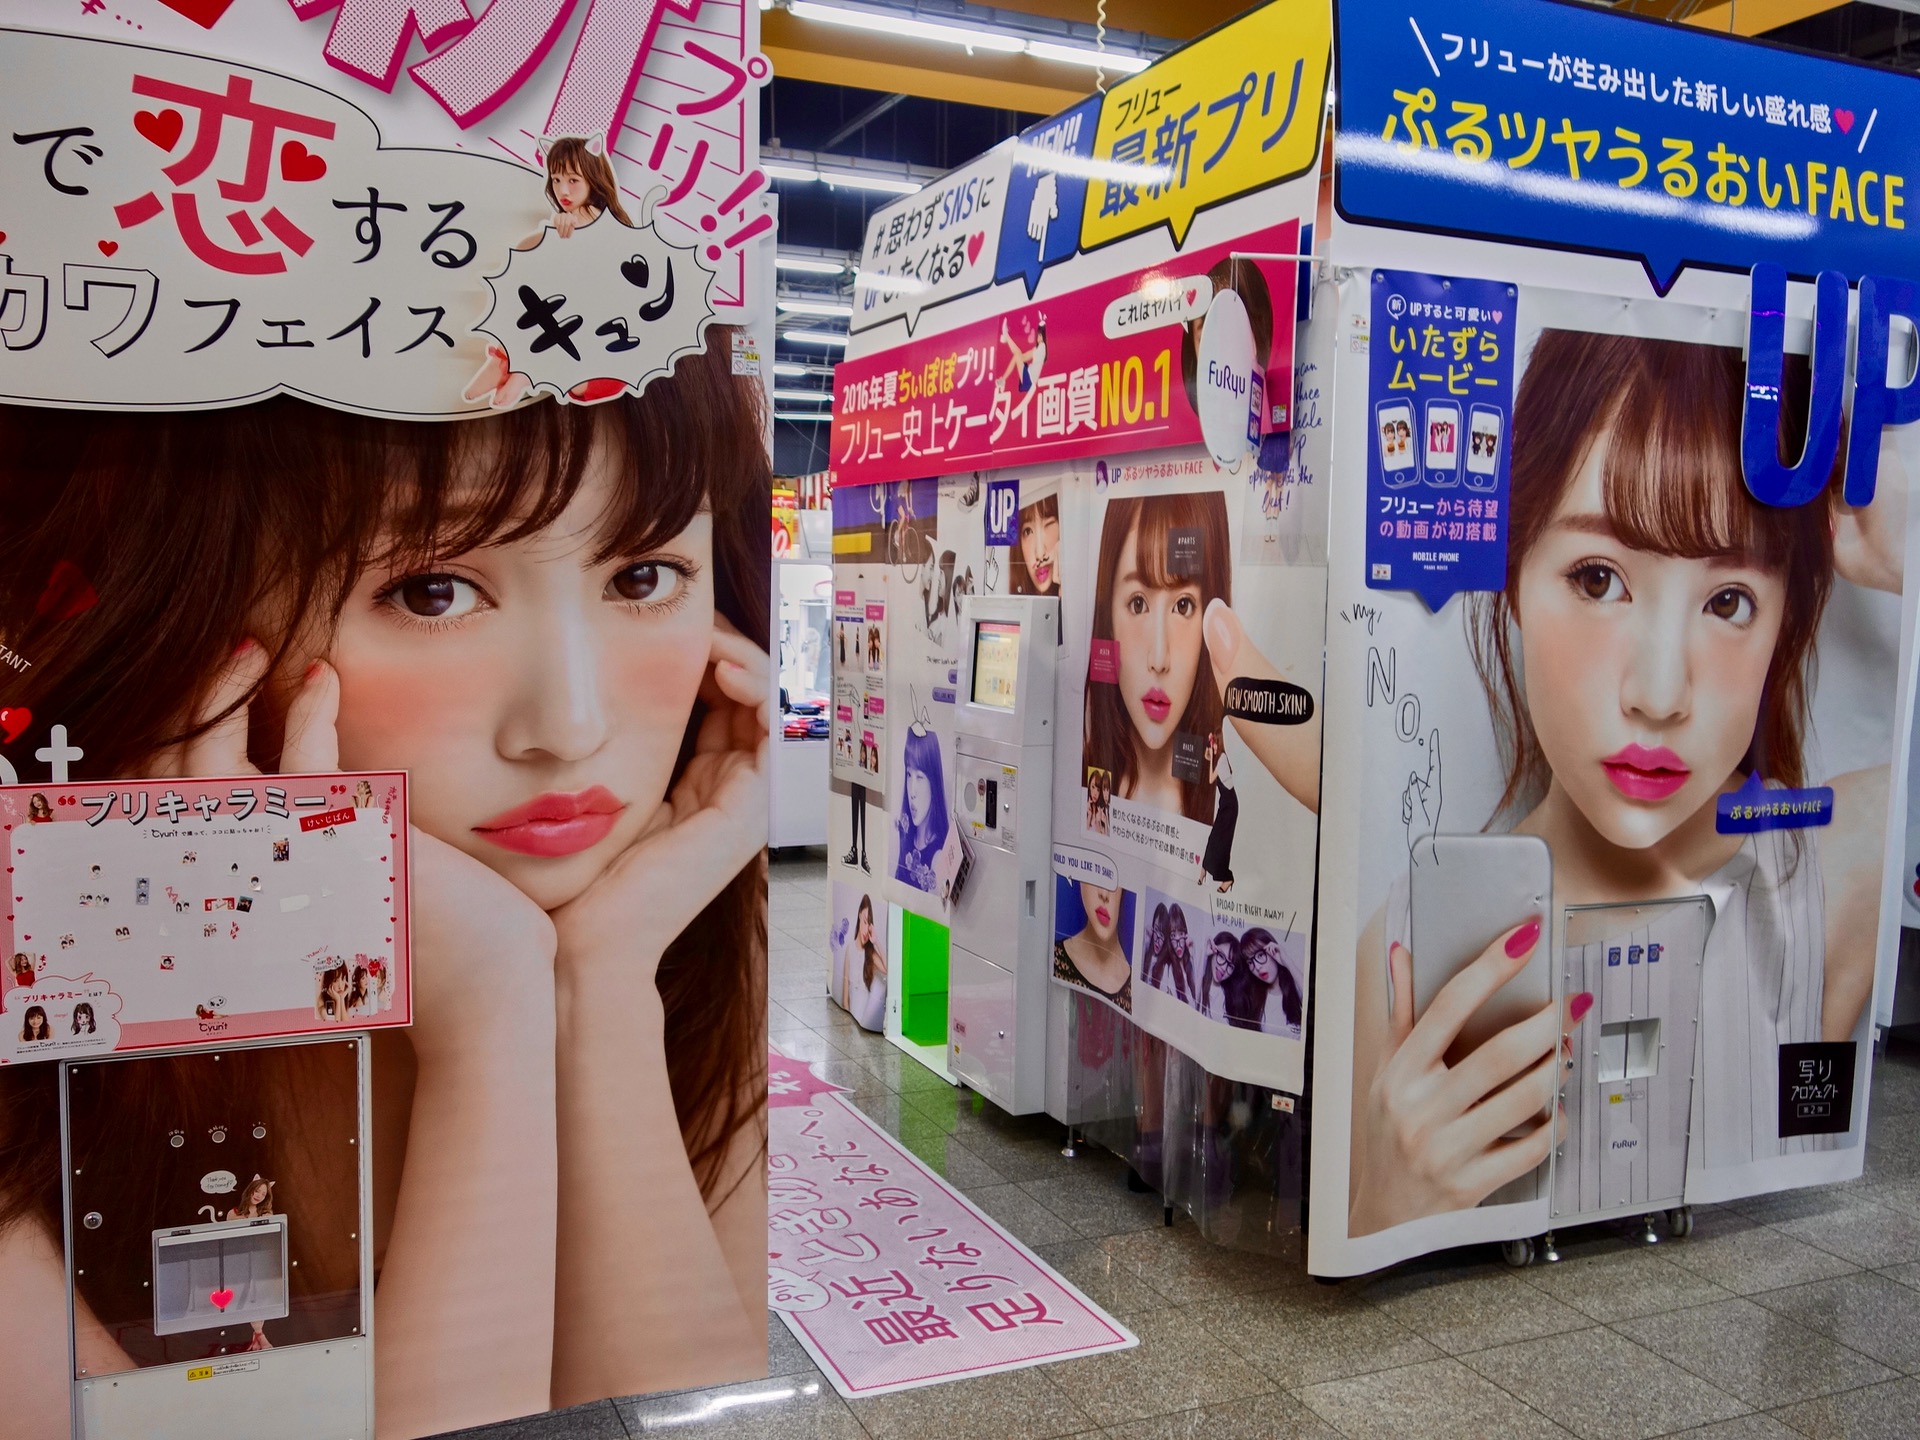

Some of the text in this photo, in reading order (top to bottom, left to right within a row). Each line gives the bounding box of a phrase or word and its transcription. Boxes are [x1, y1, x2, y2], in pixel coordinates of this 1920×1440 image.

[1440, 32, 1832, 135] フリューが生み出した新しい盛れ感
[1115, 83, 1182, 132] フリュー
[1099, 57, 1305, 218] 最新プリ
[1389, 323, 1500, 363] いたずら
[1208, 360, 1246, 399] FuRyu
[1388, 360, 1499, 395] ムービー
[1741, 262, 1920, 508] UP
[1111, 468, 1122, 484] UP
[1184, 460, 1204, 476] FACE
[990, 487, 1016, 534] UP
[1379, 496, 1499, 518] フリューから待望
[1379, 519, 1498, 542] の動画が初搭載
[1226, 687, 1308, 716] NEW SMOOTH SKIN!
[306, 811, 351, 828] けいじばん
[1068, 856, 1079, 868] YOU
[1080, 860, 1093, 871] LIKE
[1244, 903, 1262, 917] RIGHT
[1798, 1059, 1832, 1084] 写り
[1612, 1139, 1638, 1150] FuRyu
